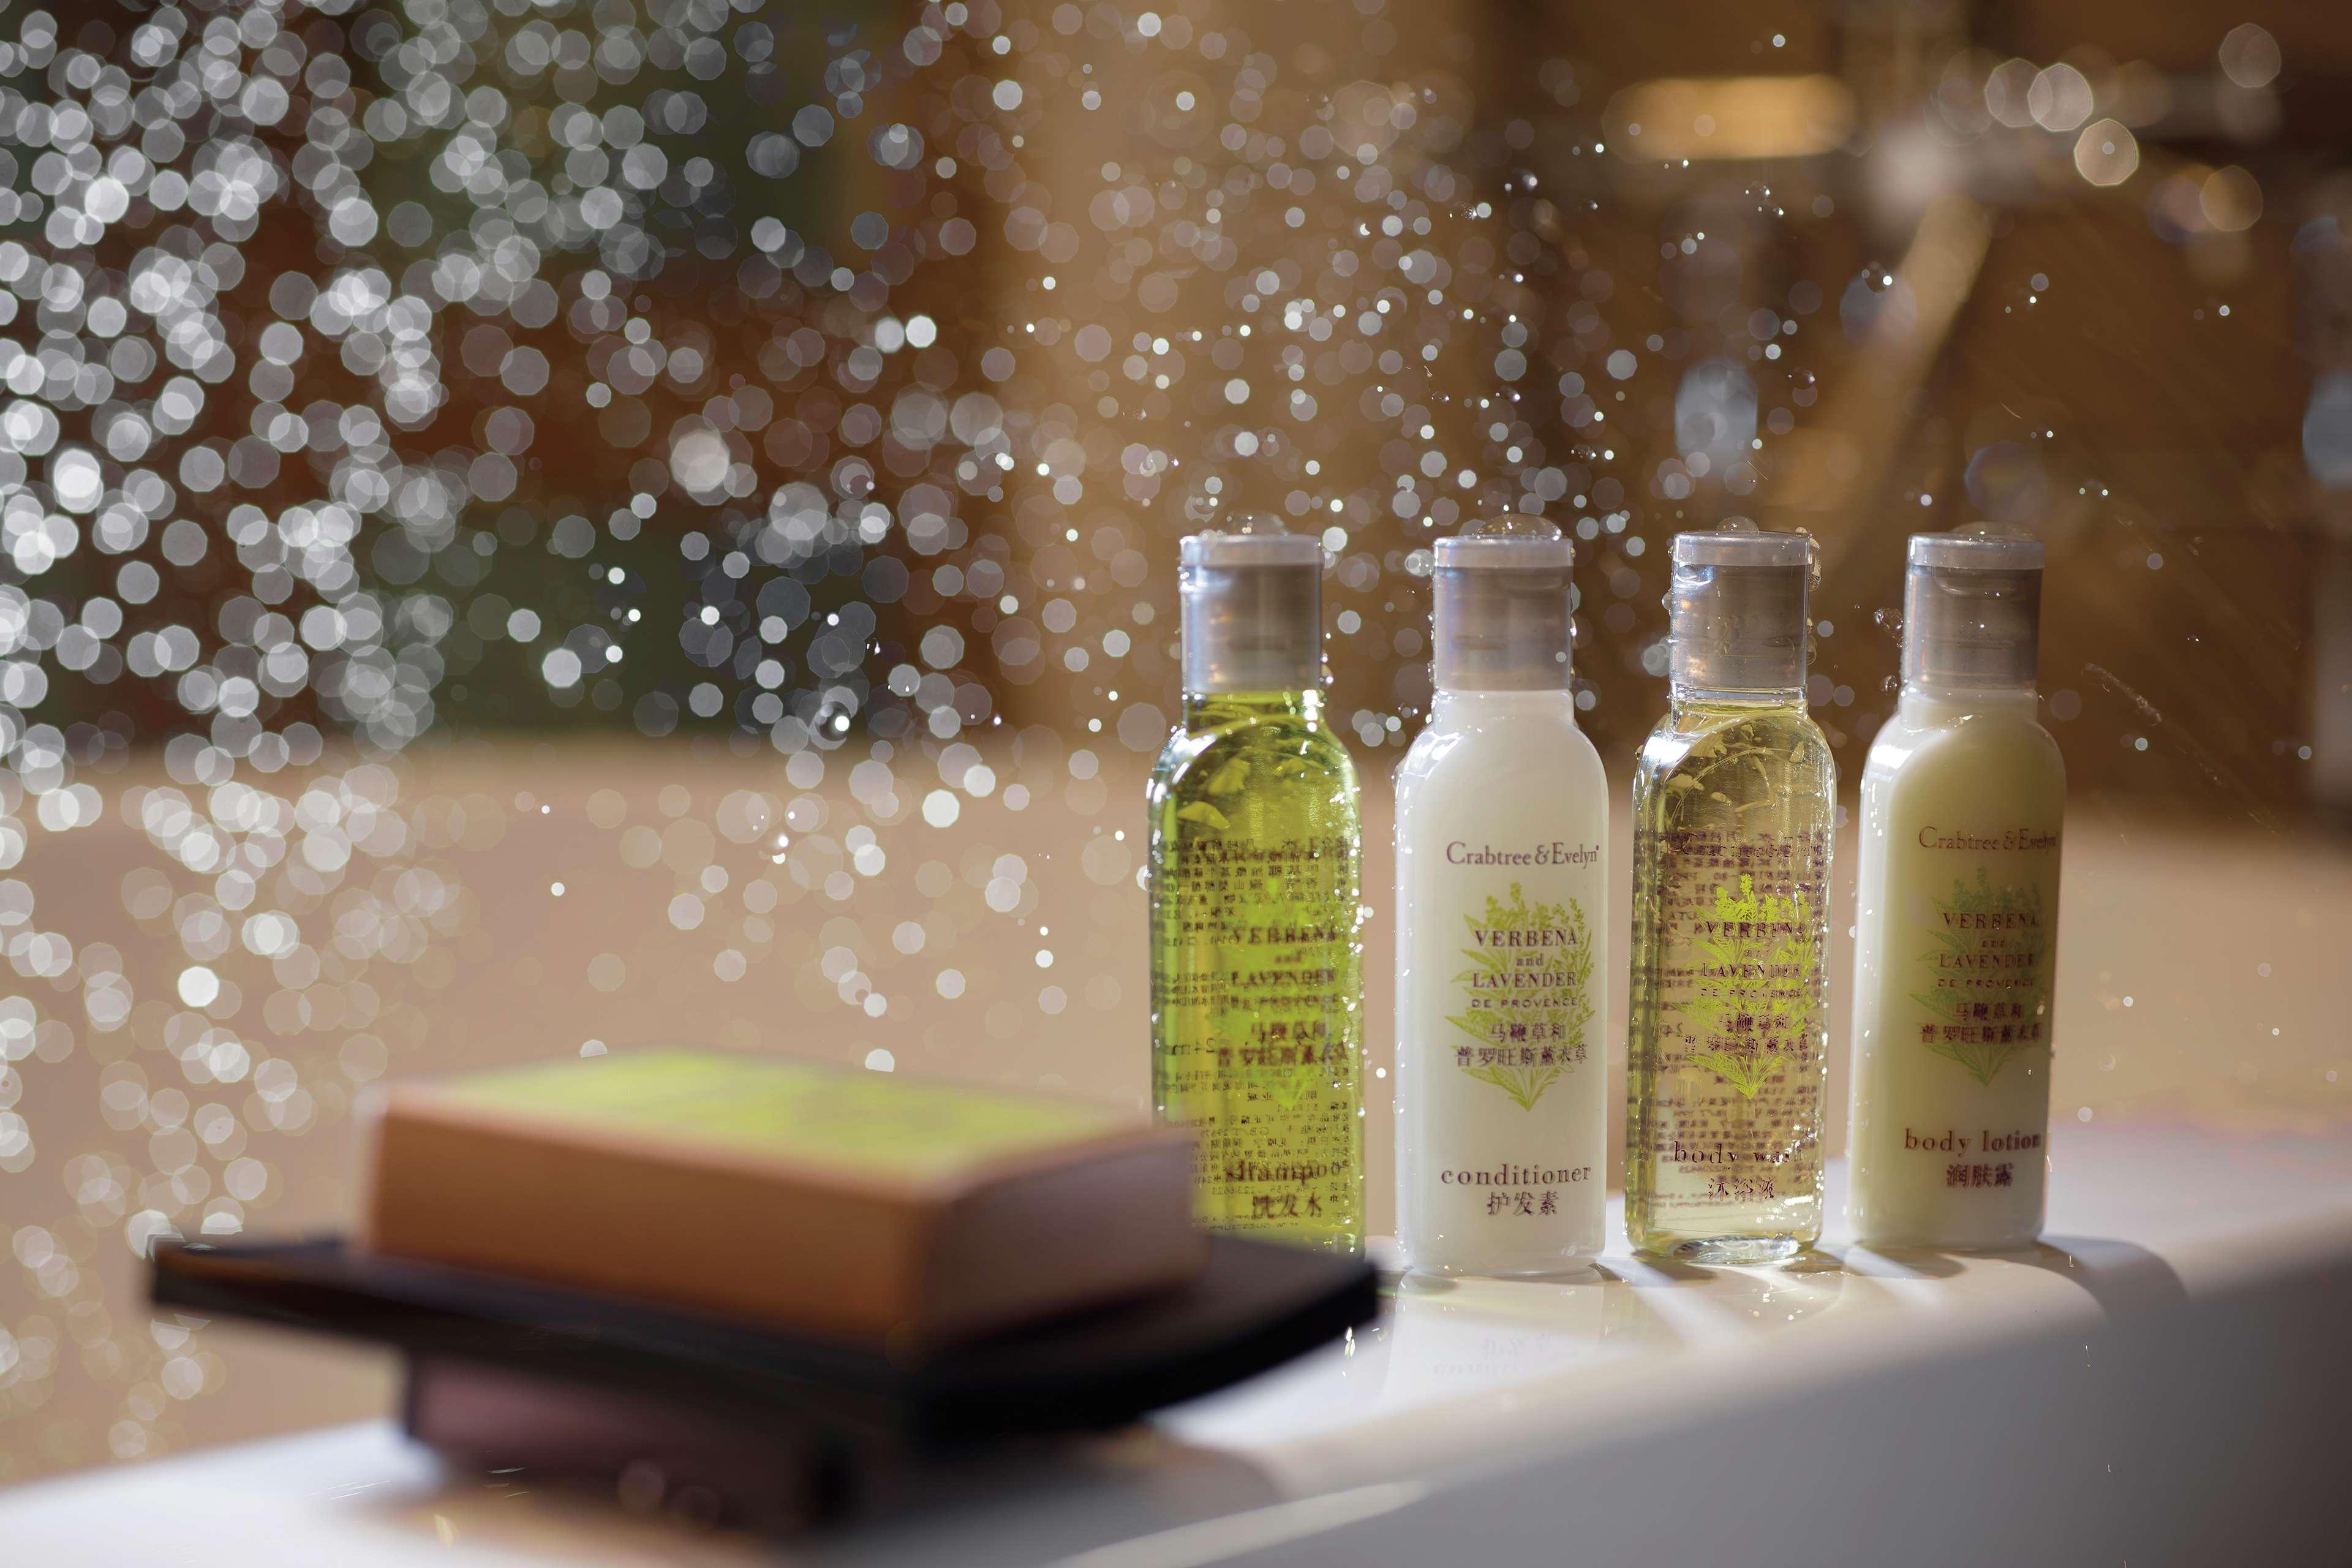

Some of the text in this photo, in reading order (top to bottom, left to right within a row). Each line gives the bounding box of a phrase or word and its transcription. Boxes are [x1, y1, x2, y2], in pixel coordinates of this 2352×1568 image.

[1918, 826, 1999, 850] Crabtree
[1446, 841, 1597, 869] Crabtree & Evelyn
[1943, 912, 2037, 929] VERBENA
[1474, 929, 1578, 947] VERBENA
[1516, 952, 1545, 967] and
[1940, 954, 2034, 969] LAVENDER
[1472, 971, 1577, 988] LAVENDER
[1471, 997, 1578, 1008] DE PROVENCE
[1488, 1022, 1566, 1042] 马鞭草和
[1904, 1128, 2041, 1157] body lotion
[1441, 1164, 1591, 1186] conditioner
[1947, 1163, 2014, 1188] 润肤露
[1487, 1190, 1559, 1216] 护发素
